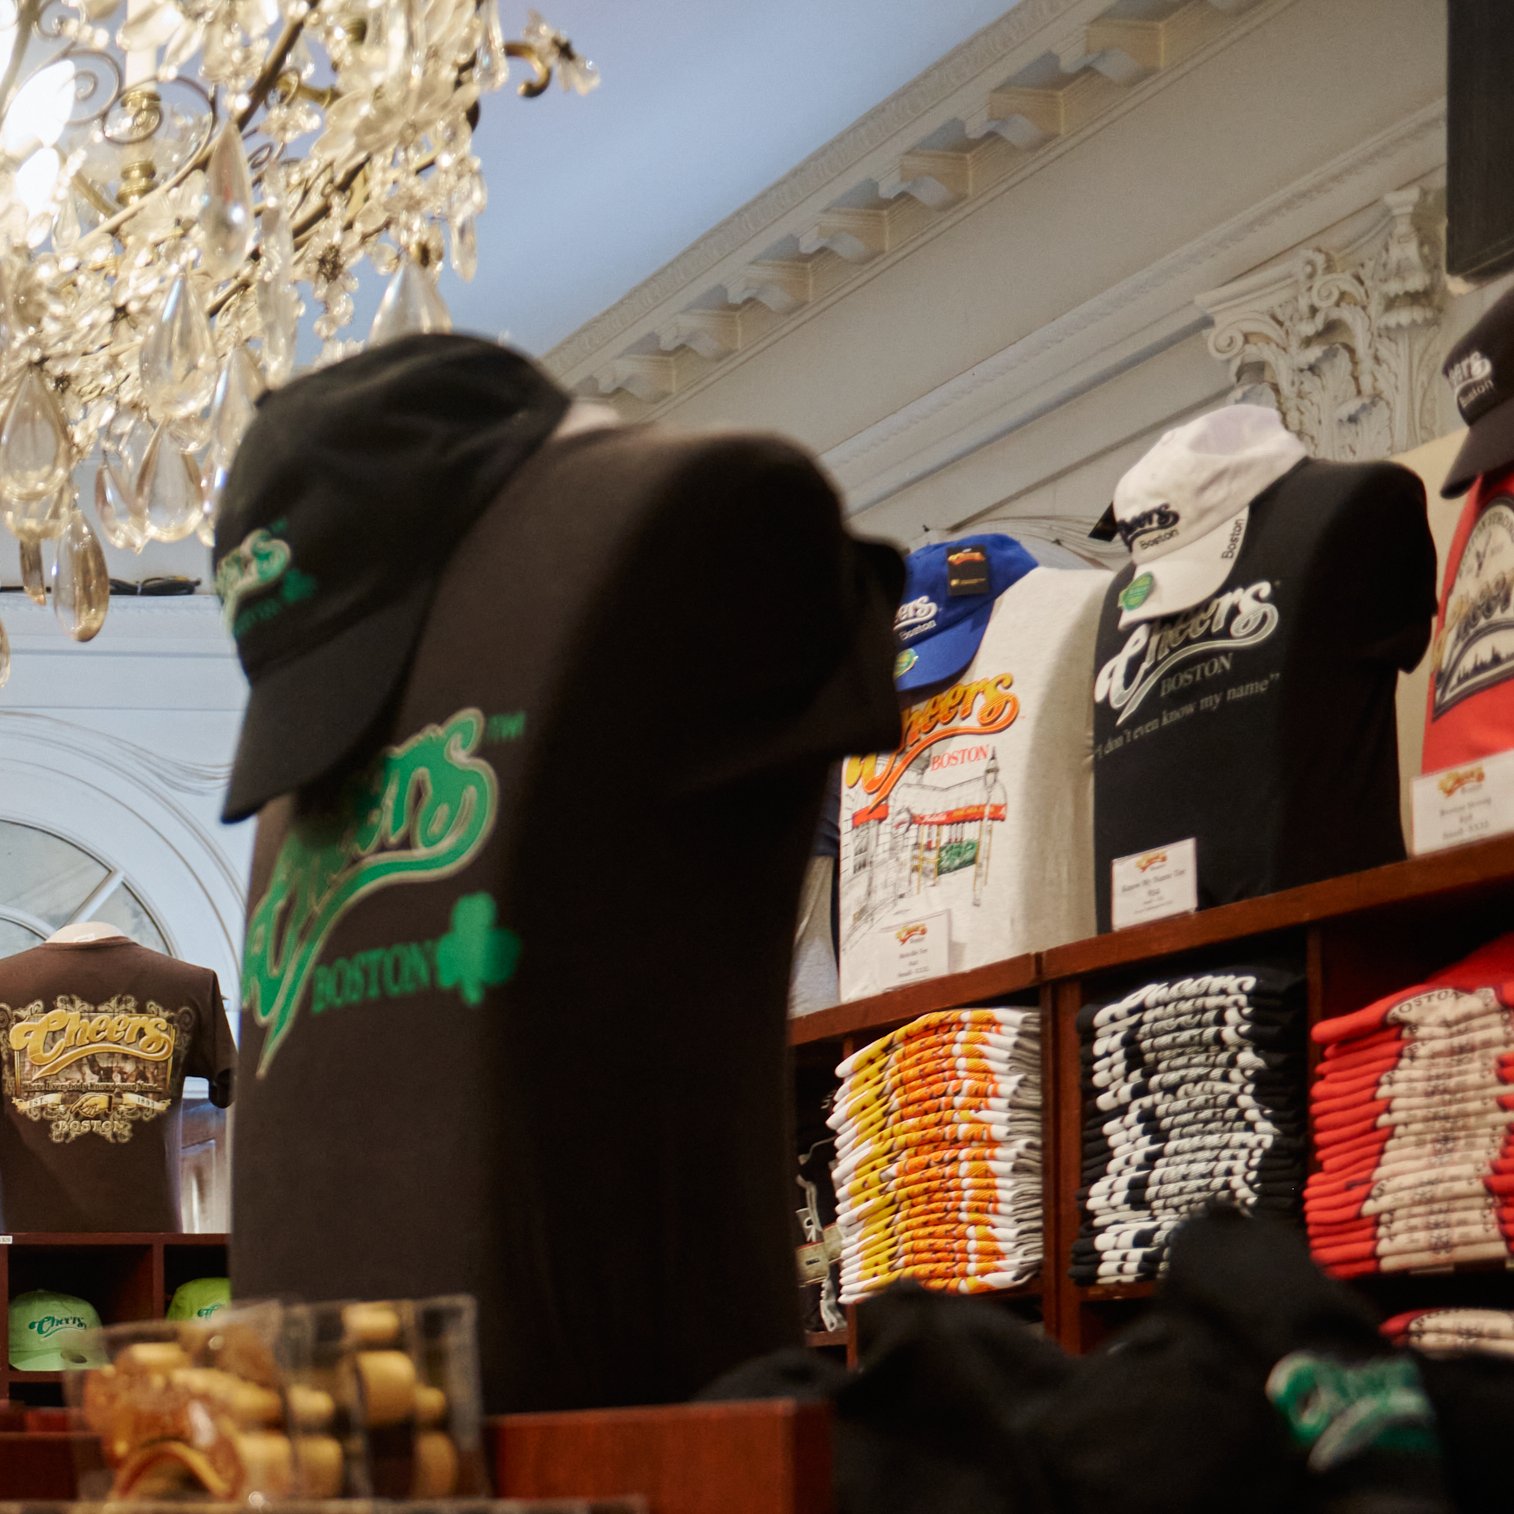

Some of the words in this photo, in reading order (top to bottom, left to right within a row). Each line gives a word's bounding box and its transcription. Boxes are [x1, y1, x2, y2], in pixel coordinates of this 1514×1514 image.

[1221, 518, 1245, 560] Boston
[1160, 652, 1234, 697] BOSTON
[1161, 701, 1197, 727] know
[1199, 692, 1223, 712] my
[930, 744, 992, 772] BOSTON
[10, 1009, 173, 1081] Cheers
[57, 1120, 124, 1132] BOSTON
[29, 1314, 87, 1341] Cheers
